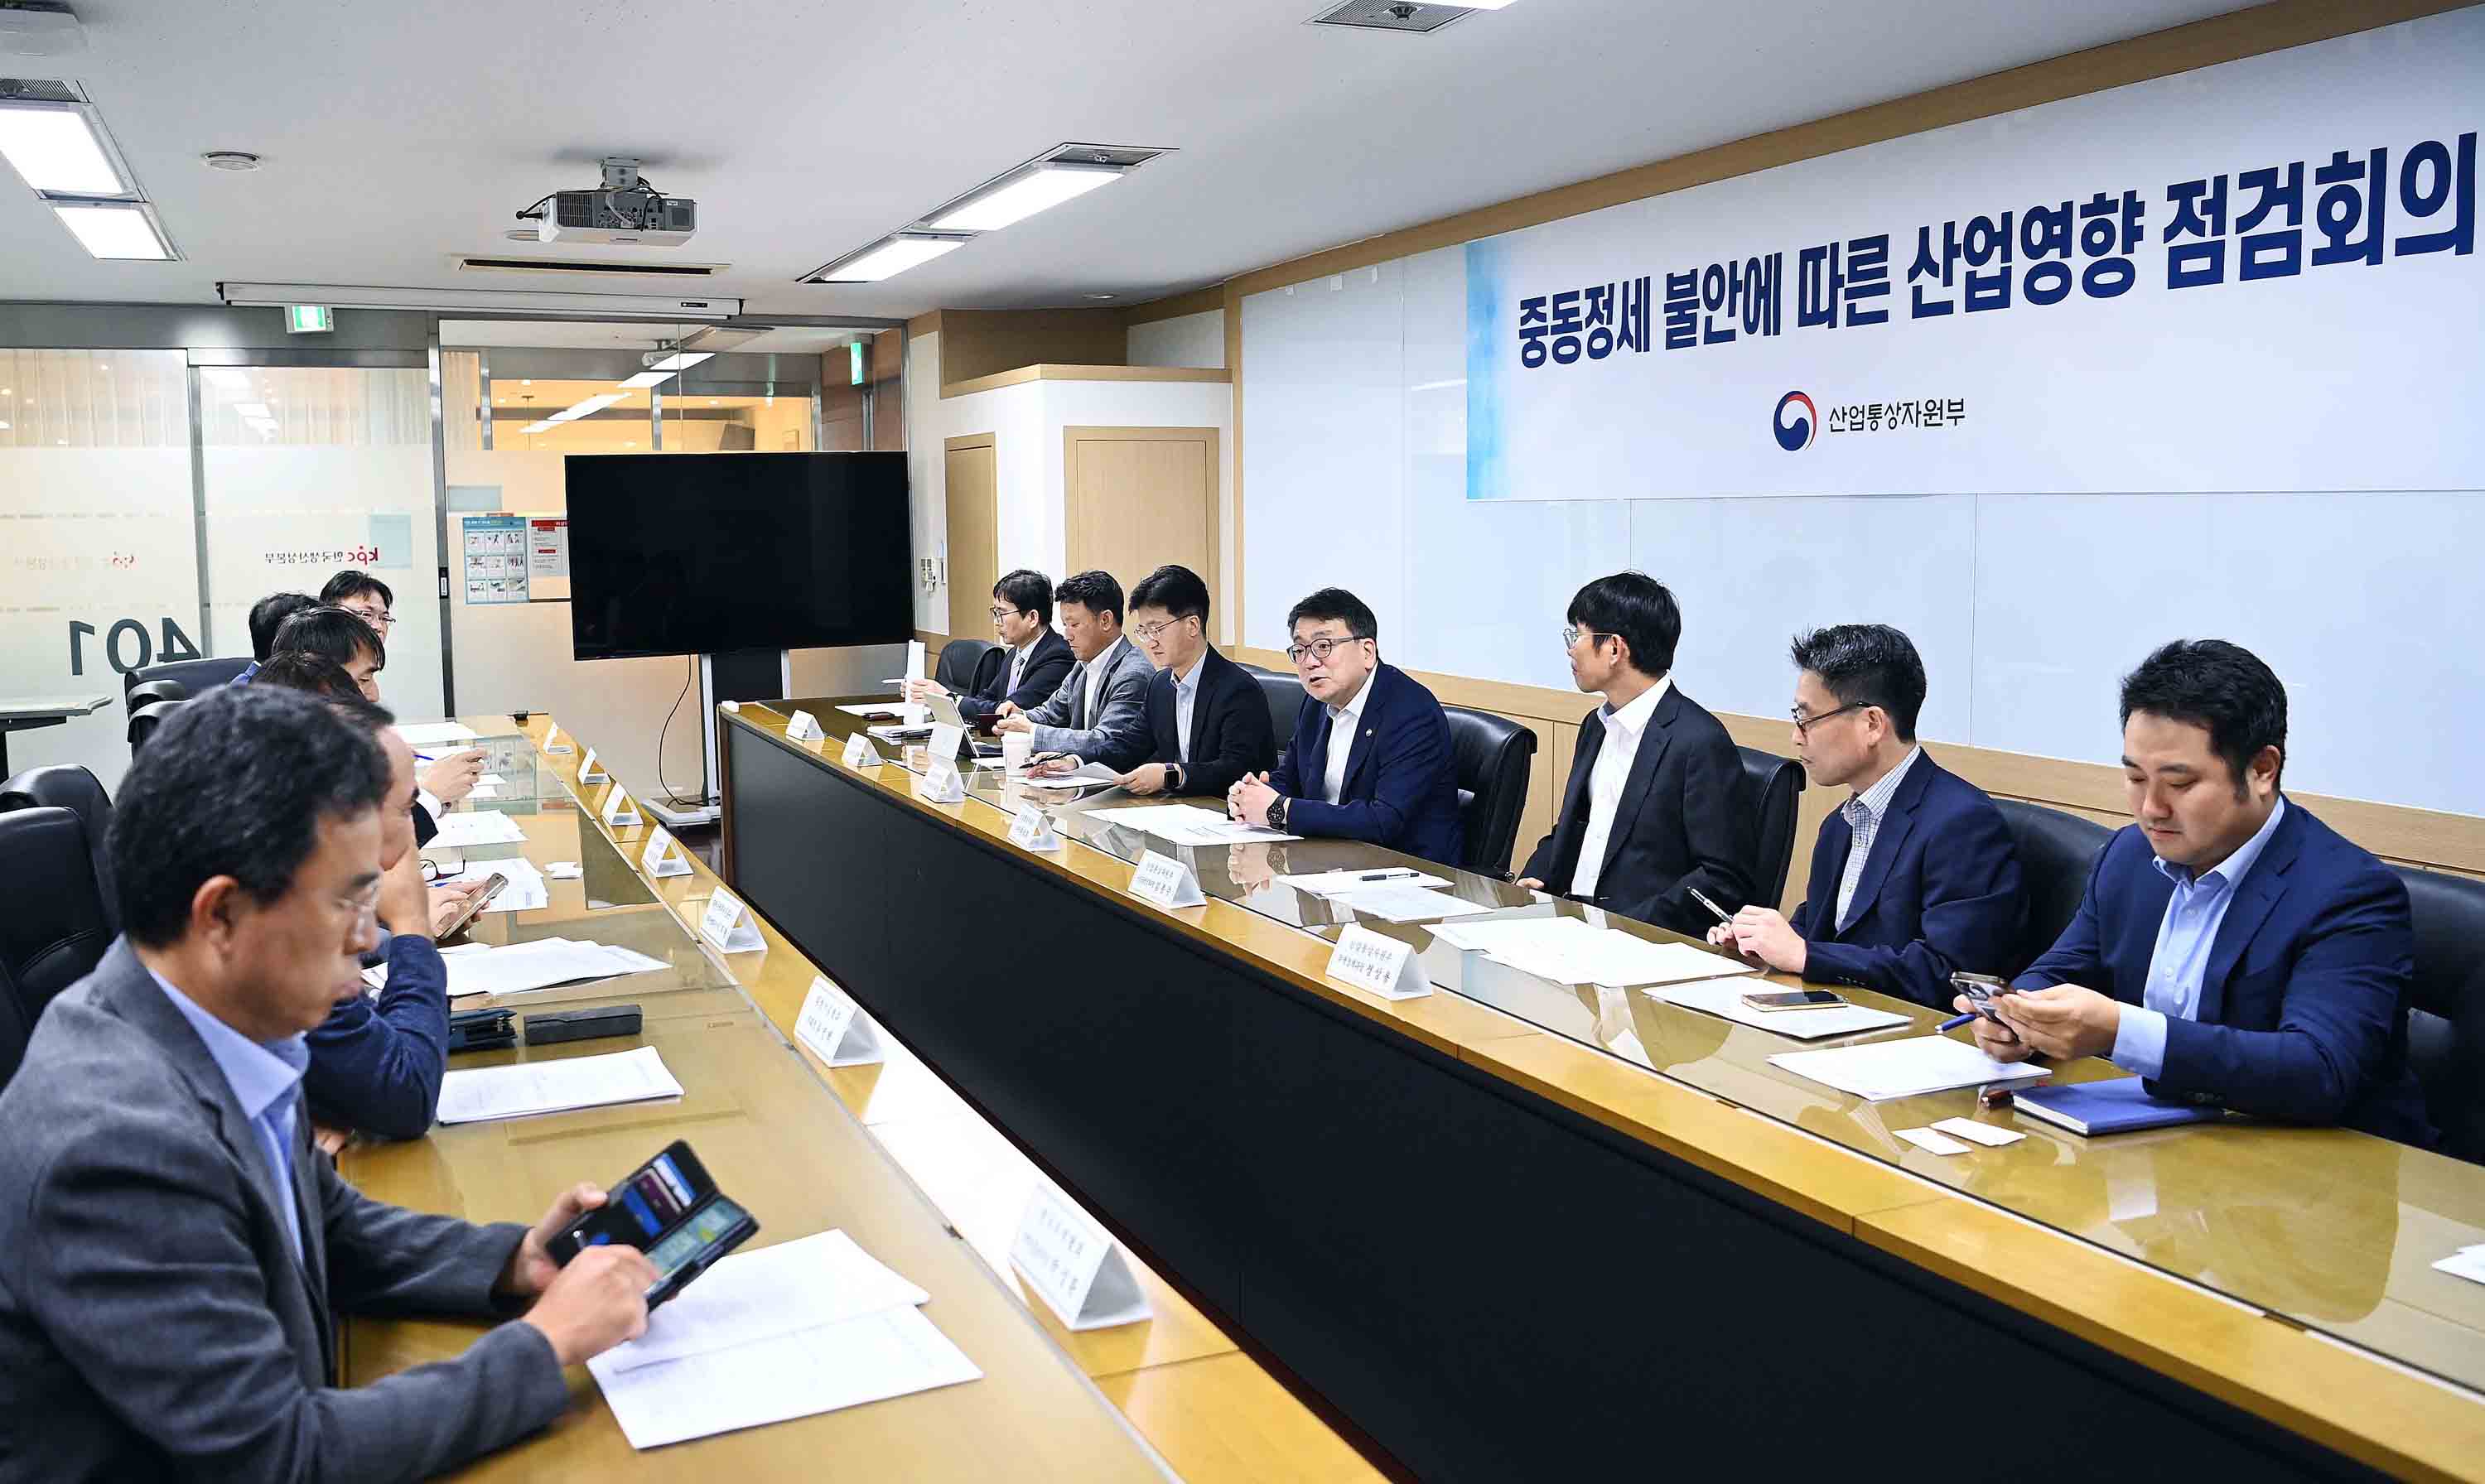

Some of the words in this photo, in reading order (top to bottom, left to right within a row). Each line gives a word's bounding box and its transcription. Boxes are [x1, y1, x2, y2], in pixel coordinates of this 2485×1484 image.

[1518, 275, 1651, 369] 중동정세
[1662, 251, 1783, 351] 불안에
[1797, 234, 1891, 330] 따른
[1906, 189, 2146, 320] 산업영향
[2162, 132, 2478, 290] 점검회의
[1829, 398, 1966, 433] 산업통상자원부
